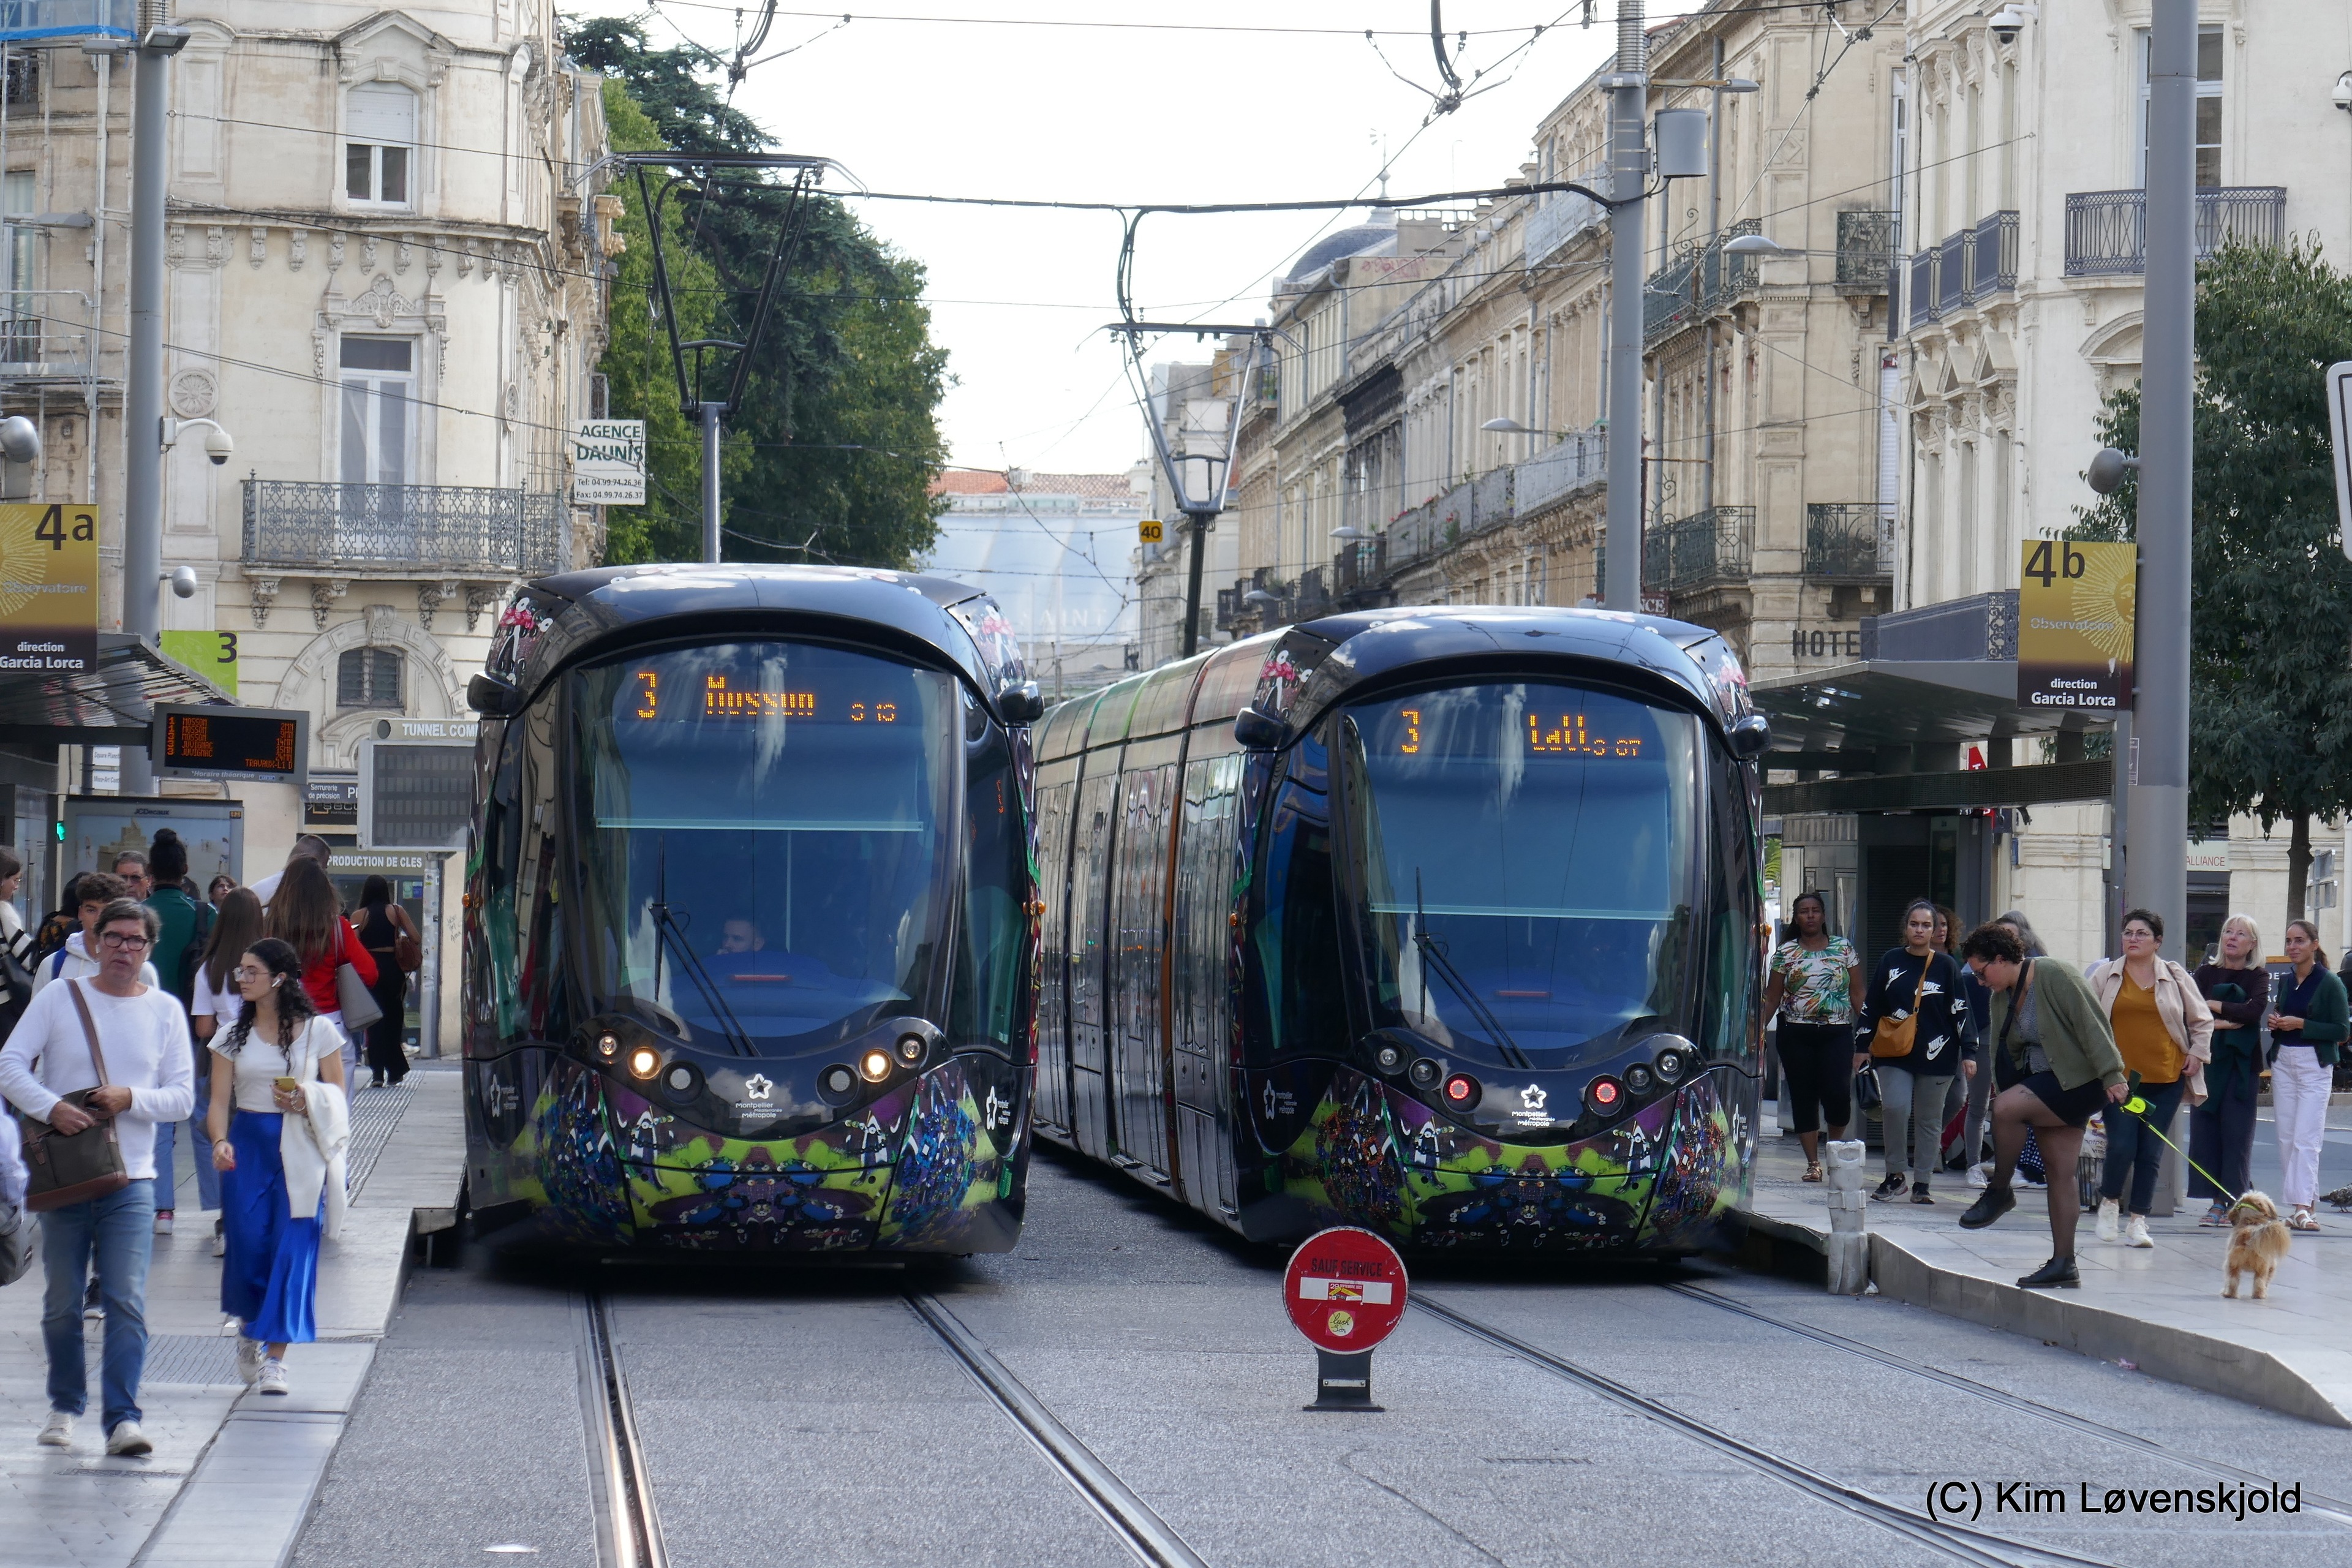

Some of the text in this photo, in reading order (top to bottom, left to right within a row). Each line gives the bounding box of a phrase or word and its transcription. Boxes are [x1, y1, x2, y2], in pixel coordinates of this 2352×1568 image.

[581, 425, 641, 438] AGENCE
[577, 445, 643, 461] DAUNIS
[35, 504, 94, 550] 4a
[1140, 526, 1161, 538] 40
[2025, 541, 2085, 587] 4b
[17, 642, 64, 652] direction
[217, 632, 237, 663] 3
[0, 656, 84, 669] Garcia Lorca
[2051, 678, 2097, 689] direction
[638, 673, 656, 718] 3
[2031, 692, 2116, 706] Garcia Lorca
[183, 717, 207, 726] MOSSON
[402, 723, 447, 737] TUNNEL
[1402, 710, 1419, 753] 3
[182, 741, 213, 749] JUVIGNAC
[181, 748, 213, 757] JUVIGNAC
[316, 791, 340, 800] précision
[386, 857, 398, 867] DE
[400, 858, 422, 867] CLES
[2187, 856, 2225, 866] ALLIANCE
[1923, 981, 1941, 992] NIKE
[1928, 1035, 1944, 1052] NIKE
[1311, 1257, 1382, 1277] SAUF SERVICE
